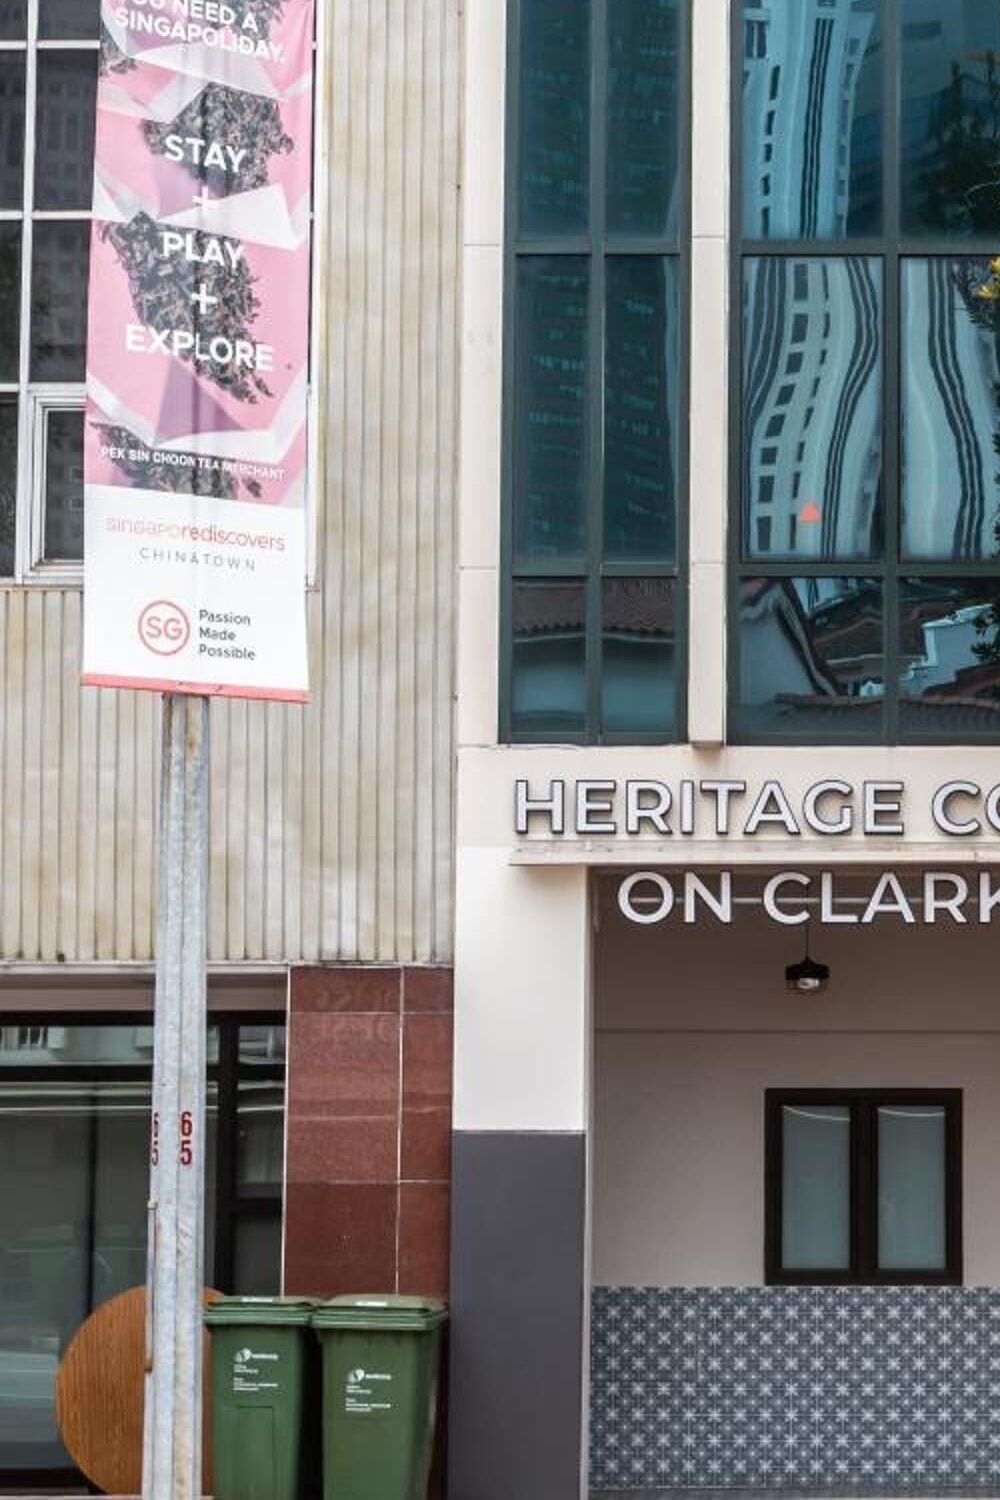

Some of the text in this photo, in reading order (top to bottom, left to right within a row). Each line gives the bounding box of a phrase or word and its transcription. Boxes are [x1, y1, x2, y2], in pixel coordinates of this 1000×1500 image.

[241, 11, 259, 34] A
[164, 133, 246, 174] STAY
[162, 230, 245, 270] PLAY
[125, 323, 274, 373] EXPLORE
[101, 446, 126, 461] PEK
[128, 448, 150, 463] SIN
[199, 456, 219, 470] TEA
[138, 546, 256, 572] CHINATOWN
[145, 615, 183, 641] SG
[199, 608, 252, 626] Passion
[199, 626, 238, 642] Made
[199, 643, 257, 661] Possible
[514, 779, 905, 836] HERITAGE
[617, 870, 732, 926] ON
